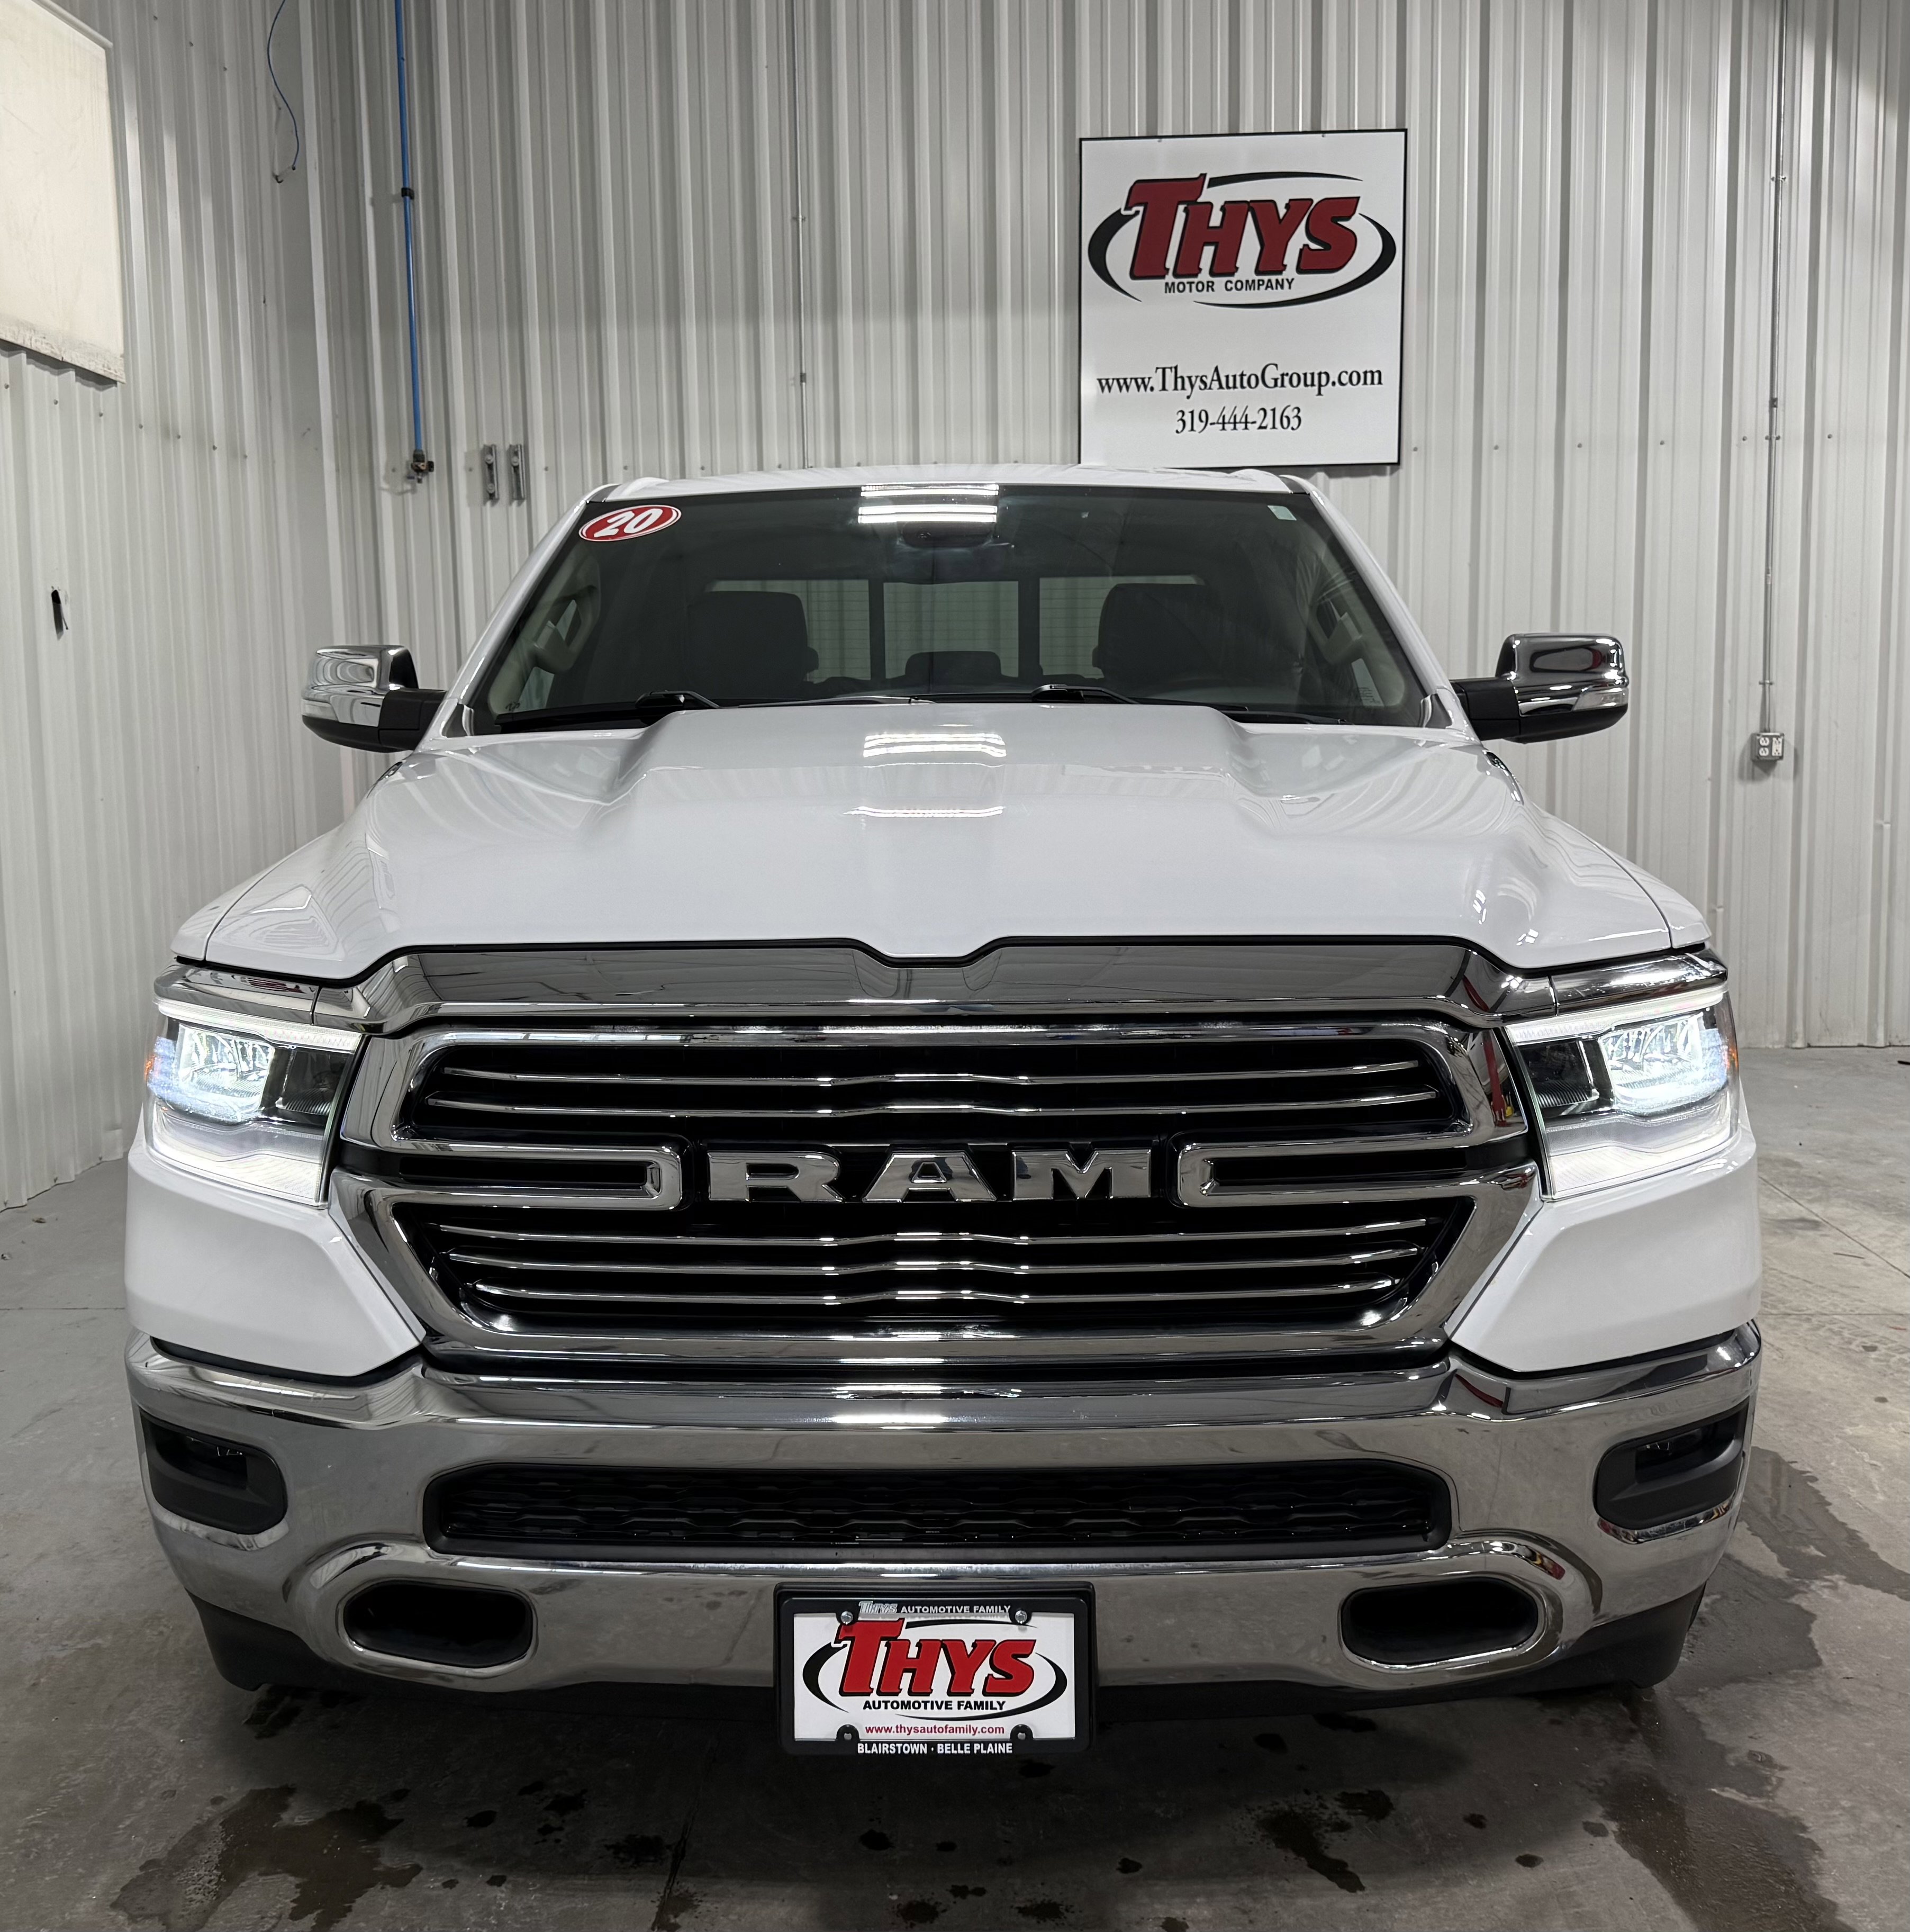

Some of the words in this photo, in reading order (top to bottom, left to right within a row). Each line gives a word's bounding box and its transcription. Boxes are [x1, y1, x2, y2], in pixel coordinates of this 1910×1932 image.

[1124, 173, 1361, 280] THYS
[1164, 281, 1215, 293] MOTOR
[1225, 278, 1295, 292] COMPANY
[1097, 363, 1383, 399] www.ThysAutoGroup.com
[1175, 404, 1302, 434] 319-444-2163
[593, 508, 663, 538] 20
[707, 1149, 1152, 1204] RAM
[834, 1619, 1036, 1697] THYS
[863, 1700, 953, 1710] AUTOMOTIVE
[957, 1700, 1006, 1710] FAMILY
[865, 1723, 1004, 1736] www.thysautofamily.com
[857, 1743, 927, 1754] BLAIRSTOWN
[937, 1743, 970, 1754] BELLE
[974, 1743, 1012, 1754] PLAINE
